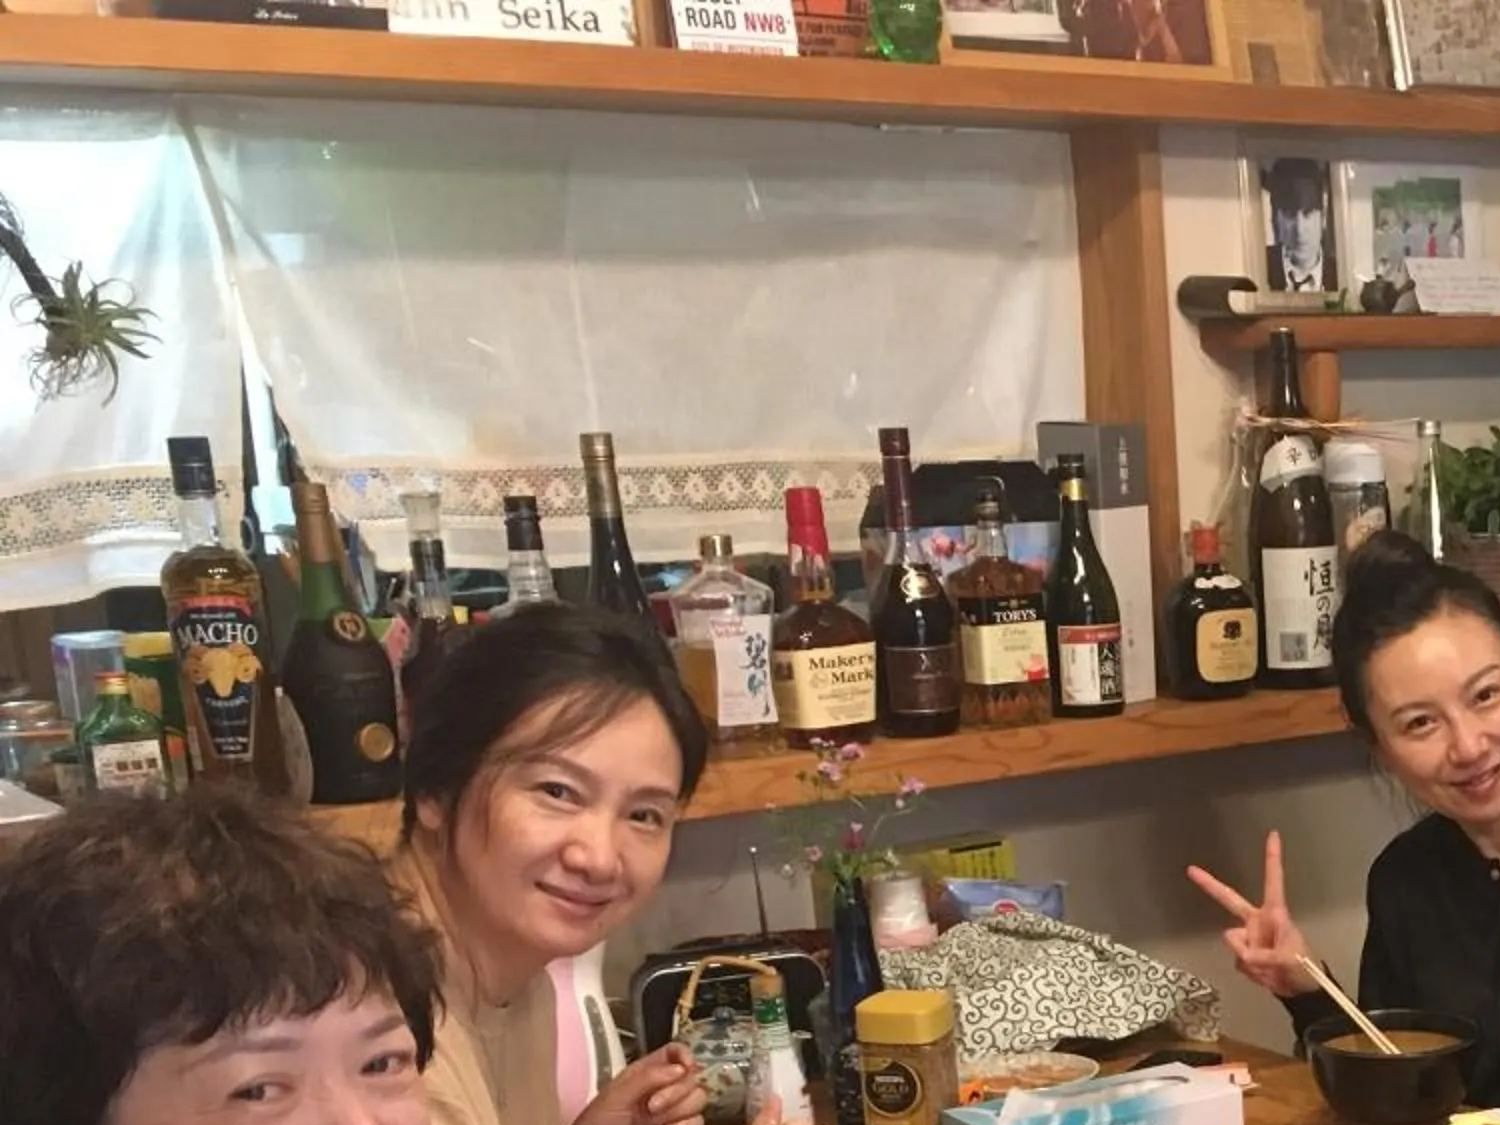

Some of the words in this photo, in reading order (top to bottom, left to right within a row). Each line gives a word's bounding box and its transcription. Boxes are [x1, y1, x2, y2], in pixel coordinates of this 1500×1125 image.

[497, 0, 601, 33] Seika
[684, 7, 737, 30] ROAD
[743, 12, 787, 34] NW8
[992, 608, 1037, 623] TORYS
[177, 622, 259, 648] MACHO
[831, 667, 874, 684] Mark
